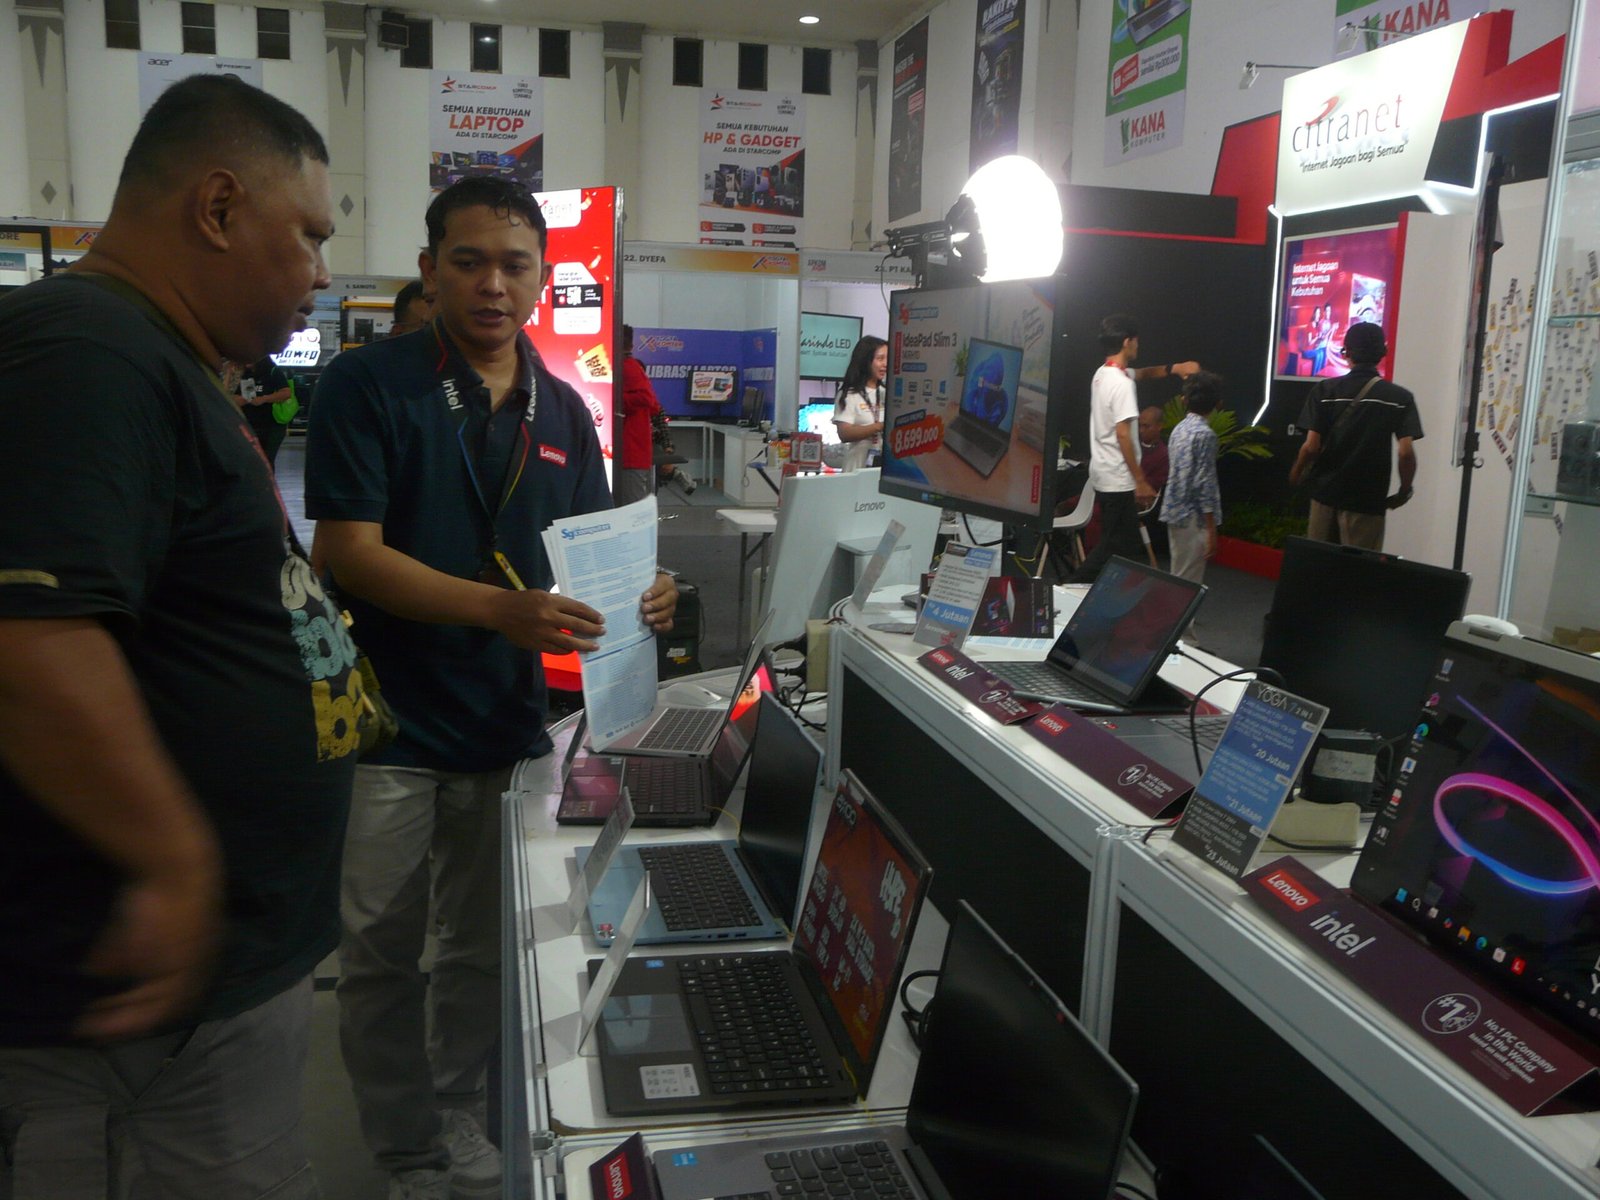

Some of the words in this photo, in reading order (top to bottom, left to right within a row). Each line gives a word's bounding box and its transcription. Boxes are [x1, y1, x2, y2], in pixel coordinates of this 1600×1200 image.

[1382, 0, 1451, 41] KANA
[147, 58, 173, 66] acer
[442, 104, 475, 114] SEMUA
[476, 106, 531, 117] KEBUTUHAN
[449, 114, 524, 133] LAPTOP
[716, 122, 742, 130] SEMUA
[743, 123, 789, 133] KEBUTUHAN
[1130, 110, 1166, 139] KANA
[480, 132, 518, 140] STARCOMP
[703, 131, 723, 144] HP
[726, 132, 736, 145] &
[740, 134, 801, 148] GADGET
[1358, 147, 1376, 162] bagi
[623, 254, 637, 262] 22.
[639, 255, 666, 263] DYEFA
[835, 338, 851, 349] LED
[903, 332, 933, 348] IdeaPad
[933, 331, 950, 347] Slim
[951, 333, 958, 347] 3
[539, 446, 567, 465] Lenovo
[854, 501, 886, 513] Lenovo
[940, 608, 970, 624] Jutaan
[1039, 715, 1064, 733] Lenovo
[1266, 752, 1290, 771] Jutaan
[1237, 802, 1264, 823] Jutaan
[1216, 854, 1240, 876] Jutaan
[1267, 873, 1309, 907] Lenovo
[1492, 1038, 1510, 1052] the
[1507, 1048, 1538, 1073] World
[1501, 1027, 1519, 1043] PC
[1514, 1040, 1557, 1074] Company
[609, 1158, 625, 1199] Lenovo
